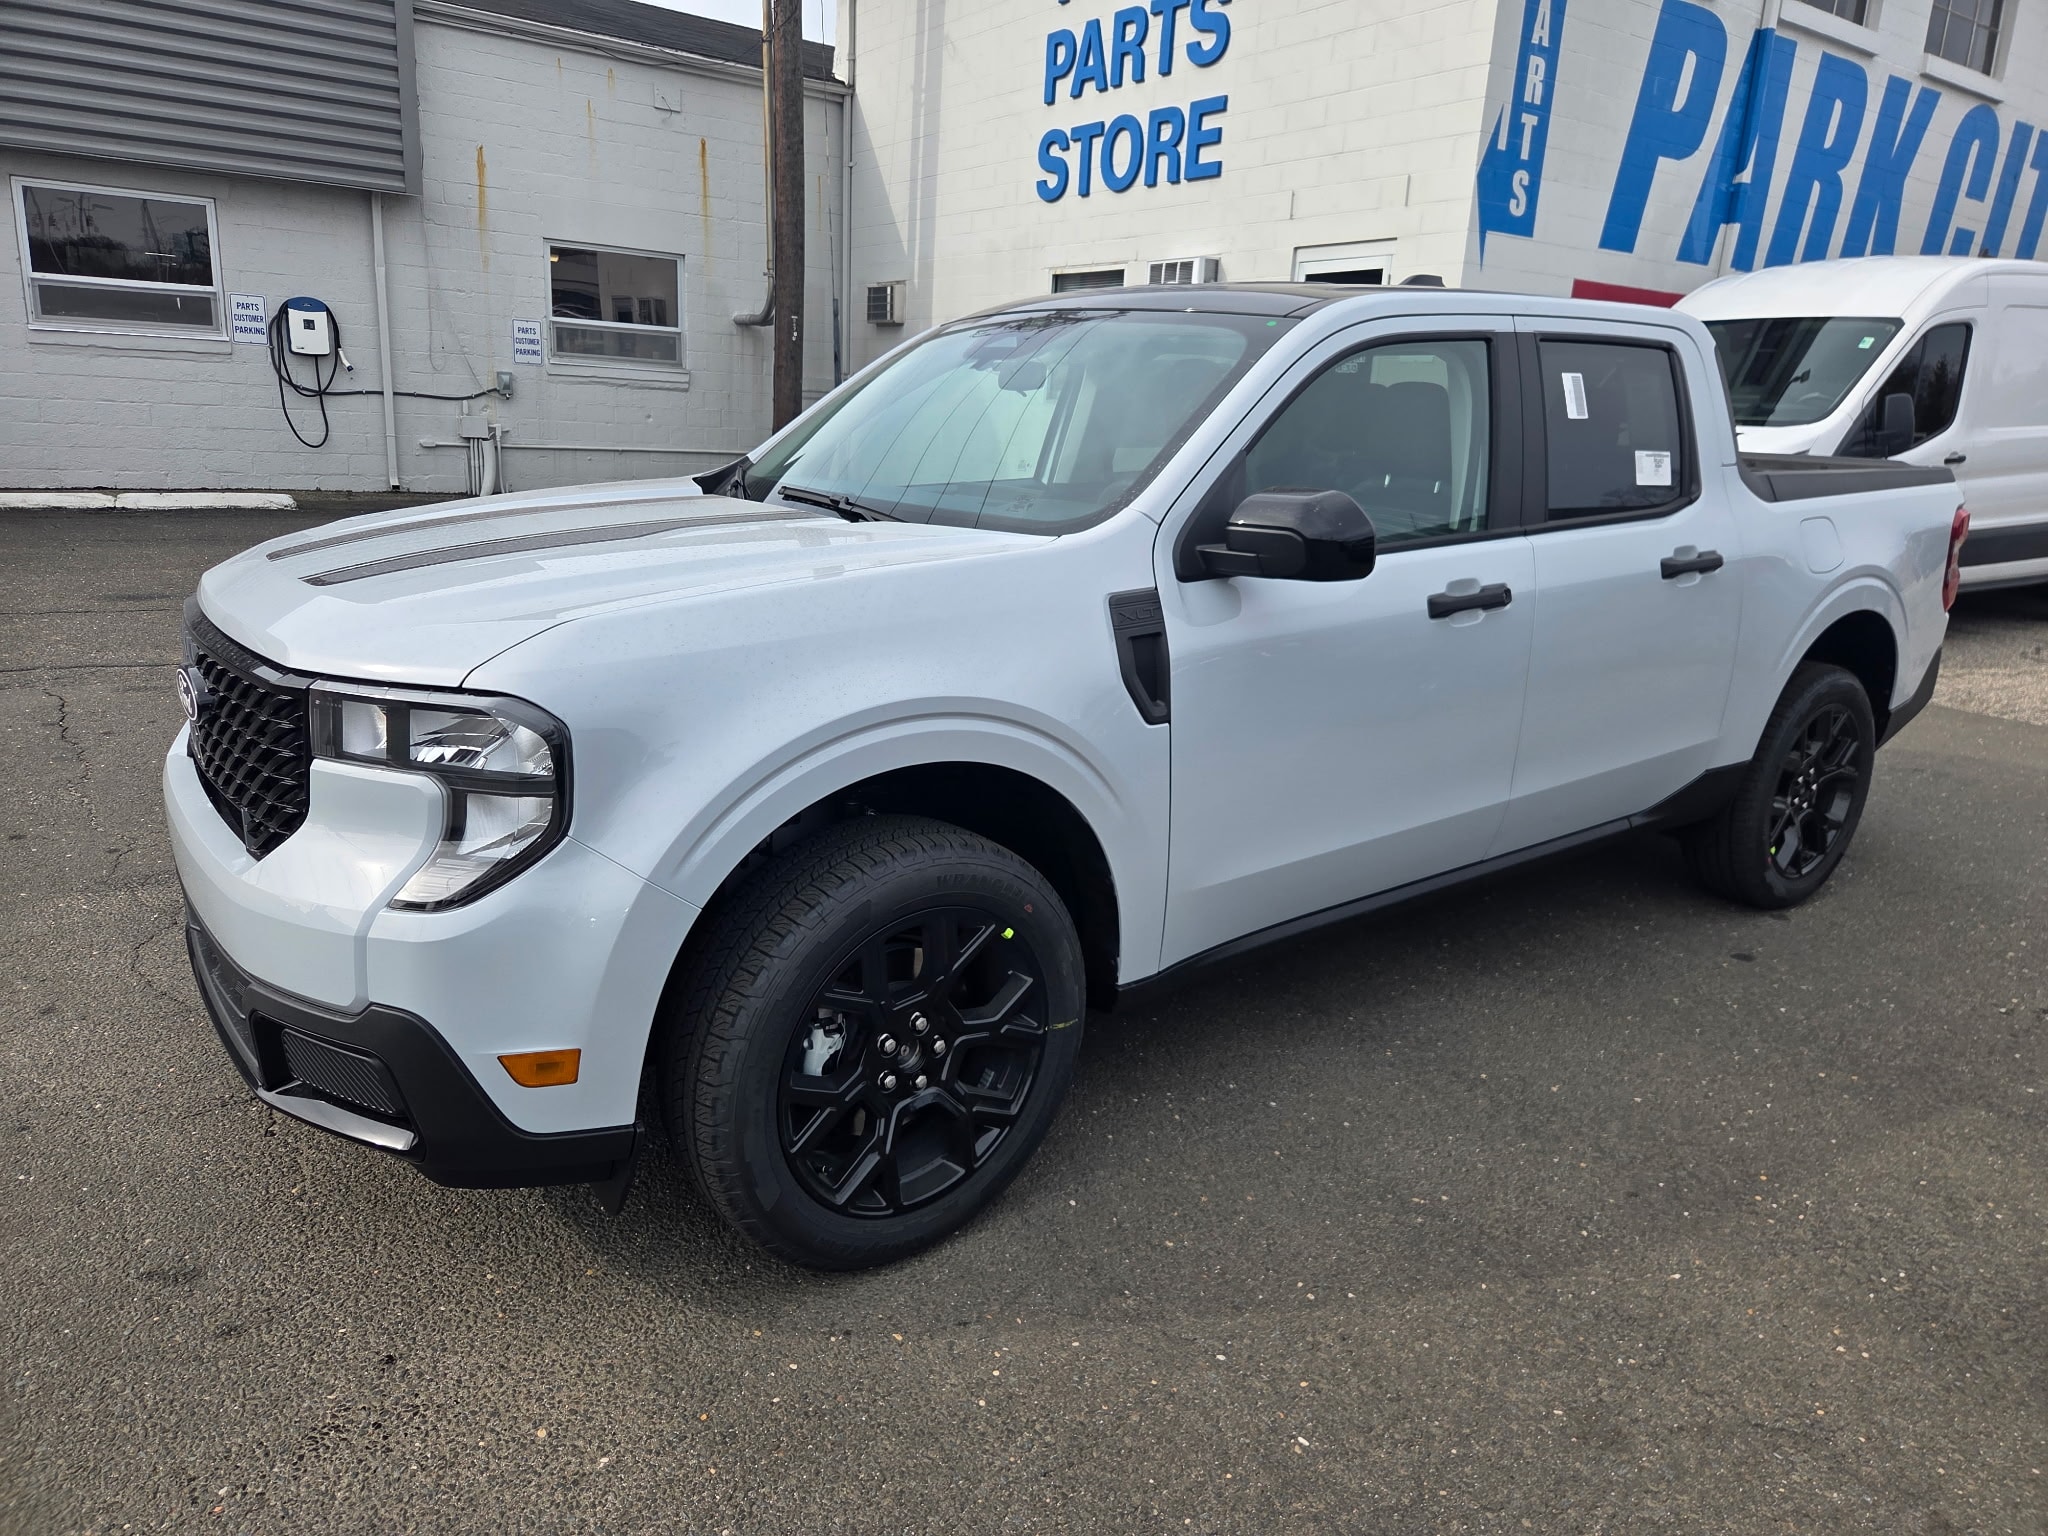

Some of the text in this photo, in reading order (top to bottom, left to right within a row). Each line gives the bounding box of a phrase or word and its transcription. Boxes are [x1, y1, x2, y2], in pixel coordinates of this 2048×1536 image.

[1044, 0, 1231, 106] PARTS
[1598, 0, 1941, 272] PARK
[1036, 95, 1228, 203] STORE
[236, 302, 260, 311] PARTS
[233, 314, 264, 323] CUSTOMER
[234, 325, 265, 335] PARKING
[517, 327, 537, 335] PARTS
[515, 337, 540, 345] CUSTOMER
[515, 348, 540, 356] PARKING
[1118, 607, 1161, 623] XLT
